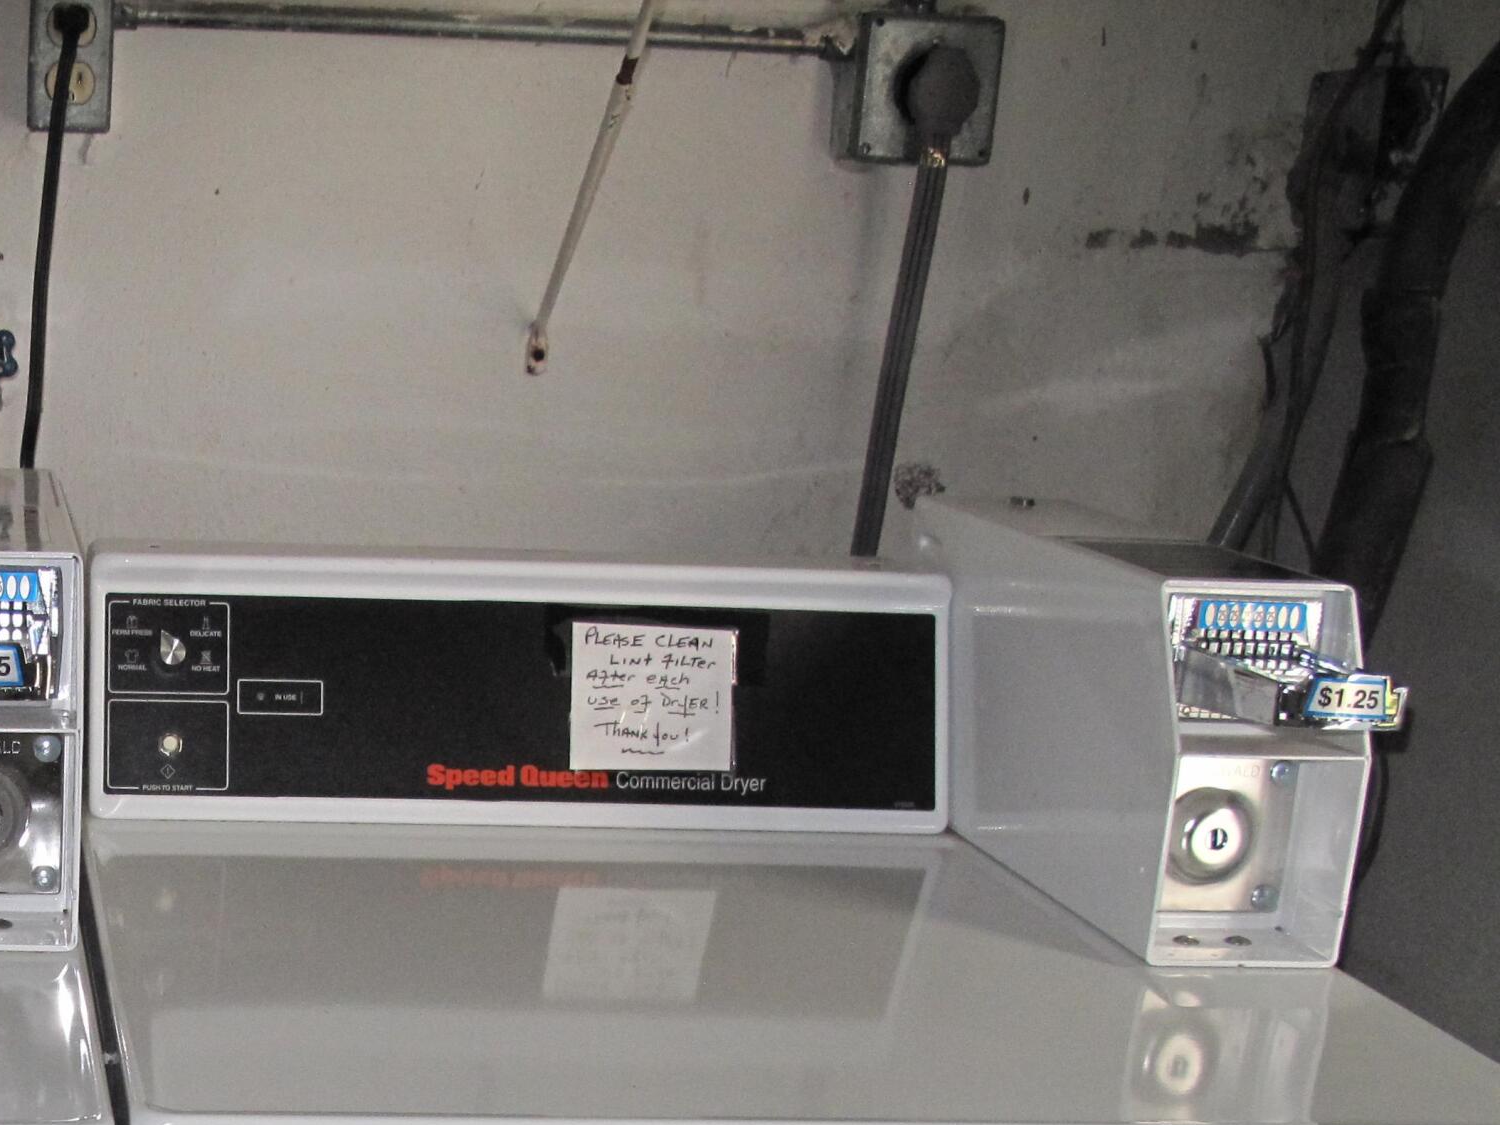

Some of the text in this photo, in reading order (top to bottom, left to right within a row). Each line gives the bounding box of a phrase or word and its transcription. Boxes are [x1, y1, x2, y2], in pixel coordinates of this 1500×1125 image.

[132, 599, 206, 607] FABRIC SELECTOR
[189, 630, 222, 638] DELICATE
[585, 625, 713, 651] PLEASE CLEAN
[630, 694, 652, 713] of
[1317, 687, 1381, 710] $1.25
[426, 763, 610, 790] Speed Queen
[616, 771, 767, 796] Commercial Dryer
[142, 784, 161, 792] PUSH
[172, 784, 194, 792] START
